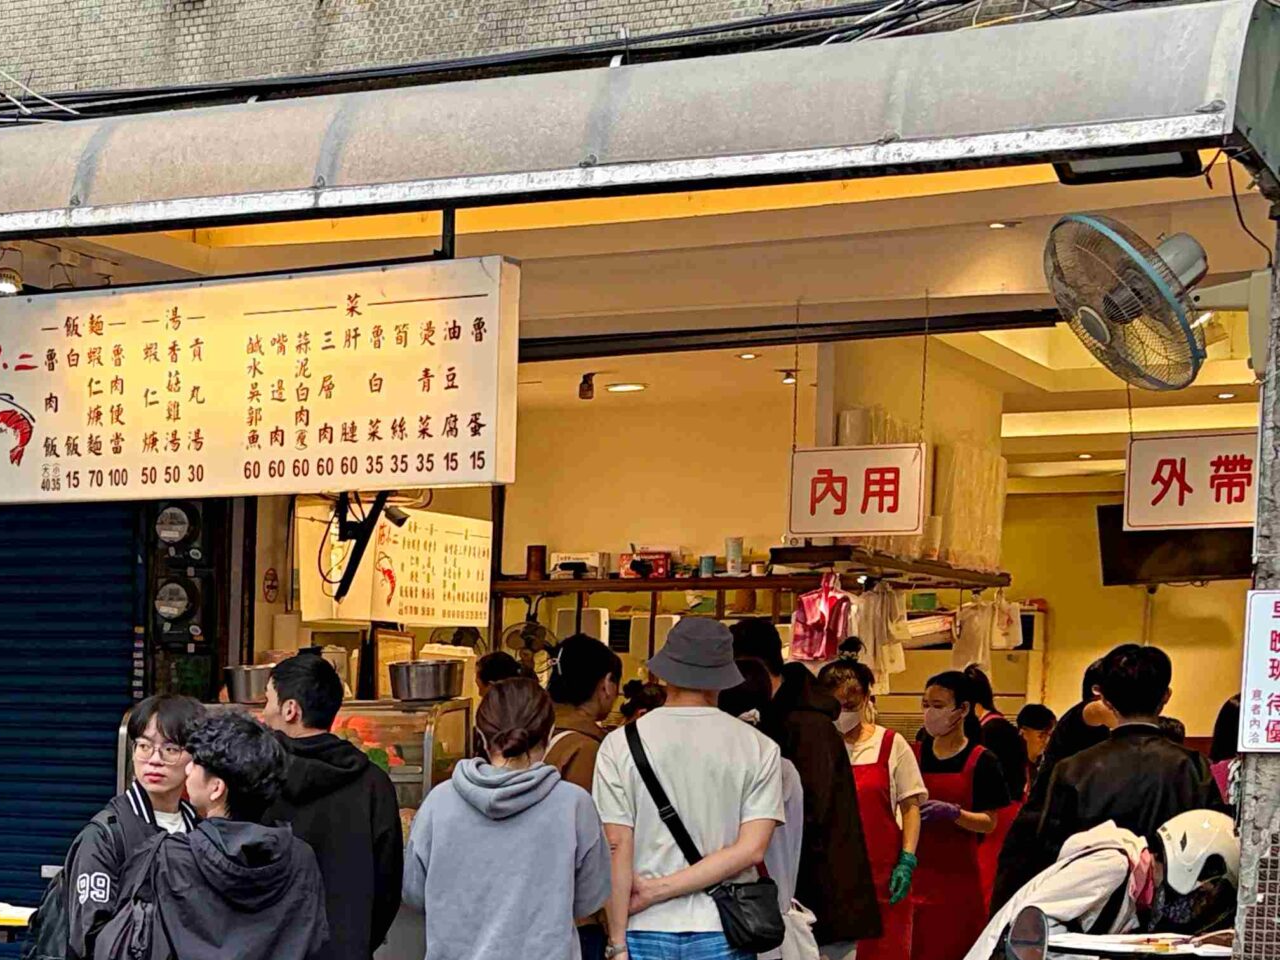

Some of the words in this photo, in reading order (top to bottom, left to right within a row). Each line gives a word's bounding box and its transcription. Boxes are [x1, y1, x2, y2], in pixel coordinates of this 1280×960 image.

[166, 306, 181, 330] 湯
[346, 293, 363, 318] 菜
[43, 348, 60, 458] 魯肉飯
[64, 348, 82, 457] 白飯
[109, 344, 125, 455] 魯肉便當
[164, 340, 181, 452] 香菇雞湯
[187, 337, 206, 451] 貢丸湯
[367, 324, 386, 442] 魯白菜
[441, 319, 462, 438] 油豆腐
[466, 316, 487, 437] 魯蛋
[41, 478, 50, 491] 40
[52, 478, 60, 491] 35
[66, 471, 80, 488] 15
[88, 469, 103, 488] 70
[108, 468, 128, 486] 100
[141, 467, 157, 484] 50
[164, 465, 181, 483] 50
[188, 464, 204, 482] 30
[244, 460, 261, 480] 60
[268, 459, 285, 478] 60
[293, 458, 309, 477] 60
[317, 457, 334, 476] 60
[340, 456, 358, 475] 60
[365, 455, 383, 474] 35
[390, 454, 408, 473] 35
[416, 453, 434, 472] 35
[444, 452, 458, 471] 15
[470, 450, 485, 470] 15
[810, 467, 900, 516] 內用
[1151, 454, 1253, 506] 外帶
[77, 872, 111, 904] 99
